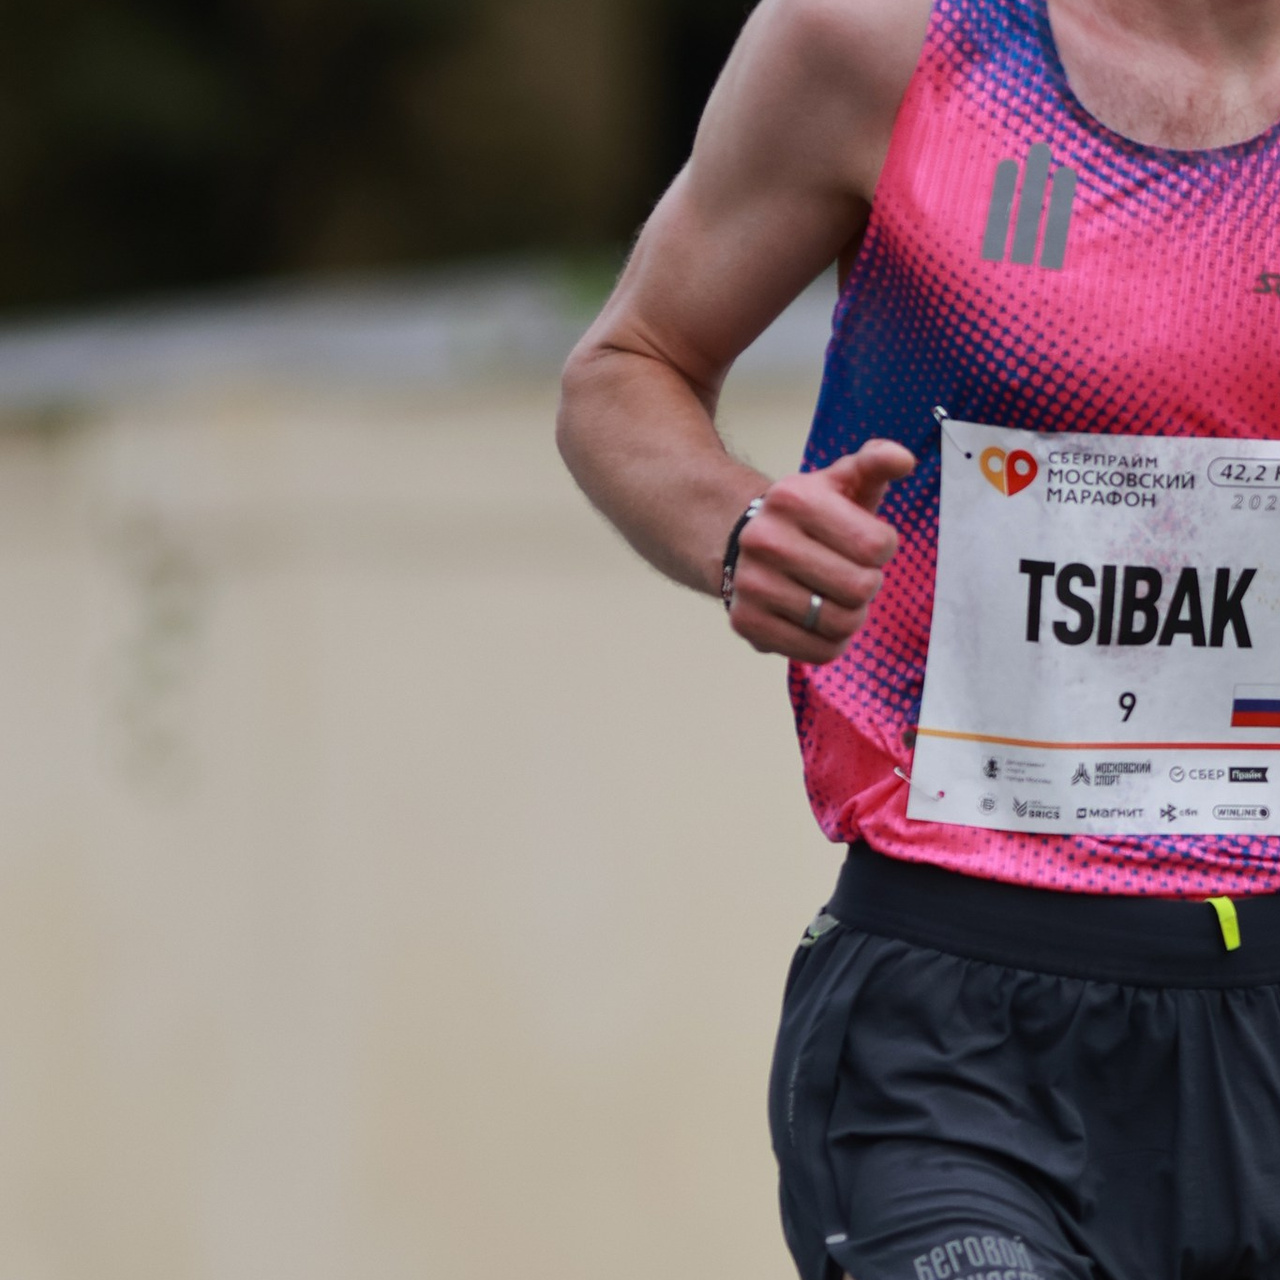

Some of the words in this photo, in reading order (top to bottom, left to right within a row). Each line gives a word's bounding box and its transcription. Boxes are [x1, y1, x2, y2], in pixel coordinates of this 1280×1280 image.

[1048, 451, 1159, 468] СБЕРПРАЙМ
[1047, 469, 1196, 490] МОСКОВСКИЙ
[1220, 464, 1267, 483] 42,2
[1046, 488, 1157, 508] МАРАФОН
[1019, 558, 1258, 649] TSIBAK
[1118, 691, 1137, 723] 9
[1094, 760, 1152, 775] МОСКОВСКИЙ
[1188, 768, 1225, 780] СБЕР
[1094, 775, 1121, 787] СПОРТ
[1217, 808, 1258, 818] WINLINE
